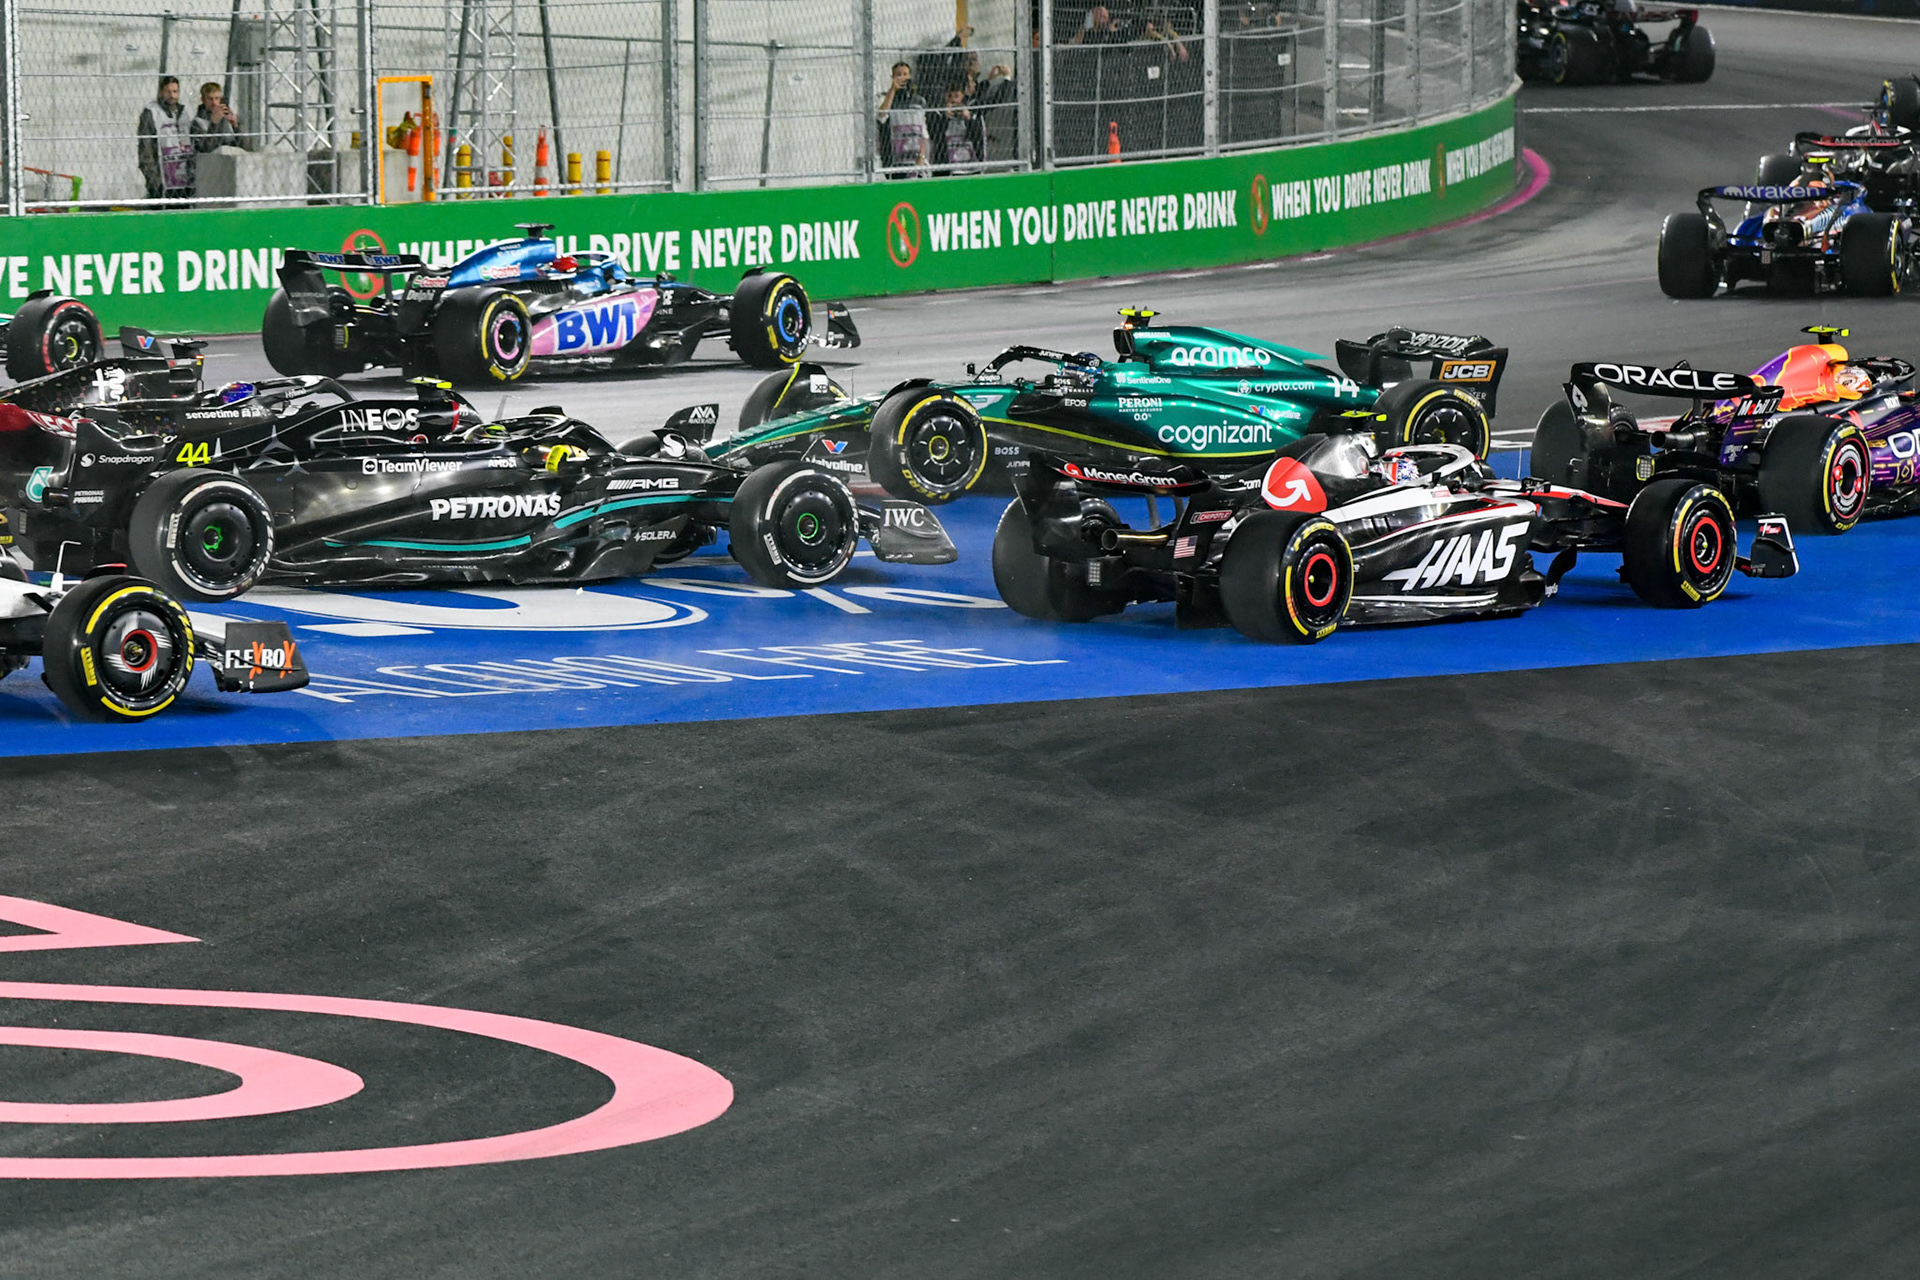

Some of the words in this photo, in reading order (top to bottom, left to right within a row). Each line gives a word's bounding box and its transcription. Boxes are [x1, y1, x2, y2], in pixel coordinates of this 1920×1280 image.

[1271, 177, 1311, 220] WHEN
[1314, 174, 1341, 214] YOU
[1344, 169, 1372, 208] DRIVE
[1373, 162, 1401, 203] NEVER
[1403, 158, 1431, 198] DRINK
[1743, 184, 1820, 199] kraken
[928, 209, 1001, 252] WHEN
[1007, 205, 1057, 246] YOU
[1063, 200, 1116, 242] DRIVE
[1122, 194, 1178, 236] NEVER
[1183, 189, 1237, 231] DRINK
[691, 225, 774, 270] NEVER
[780, 219, 860, 263] DRINK
[373, 254, 401, 265] BWT
[43, 252, 165, 297] NEVER
[555, 302, 636, 350] BWT
[1171, 346, 1271, 367] aramco
[1444, 365, 1490, 379] JCB
[1593, 363, 1739, 391] ORACLE
[1254, 381, 1315, 393] crypto.com
[1326, 375, 1360, 398] 14
[1064, 398, 1087, 407] EPOS
[1118, 397, 1163, 408] PERONI
[1737, 398, 1770, 416] Mobil
[185, 410, 240, 420] sensetime
[339, 408, 421, 433] INEOS
[1158, 420, 1272, 451] cognizant
[98, 454, 155, 467] Snapdragon
[176, 442, 212, 467] 44
[994, 446, 1020, 455] BOSS
[378, 458, 463, 473] TeamViewer
[629, 478, 680, 489] AMG
[1083, 466, 1179, 487] MoneyGram
[430, 492, 562, 521] PETRONAS
[883, 508, 925, 527] IWC
[640, 530, 677, 541] SOLERA
[1382, 521, 1530, 590] HAAS
[225, 640, 296, 680] FLEXBOX
